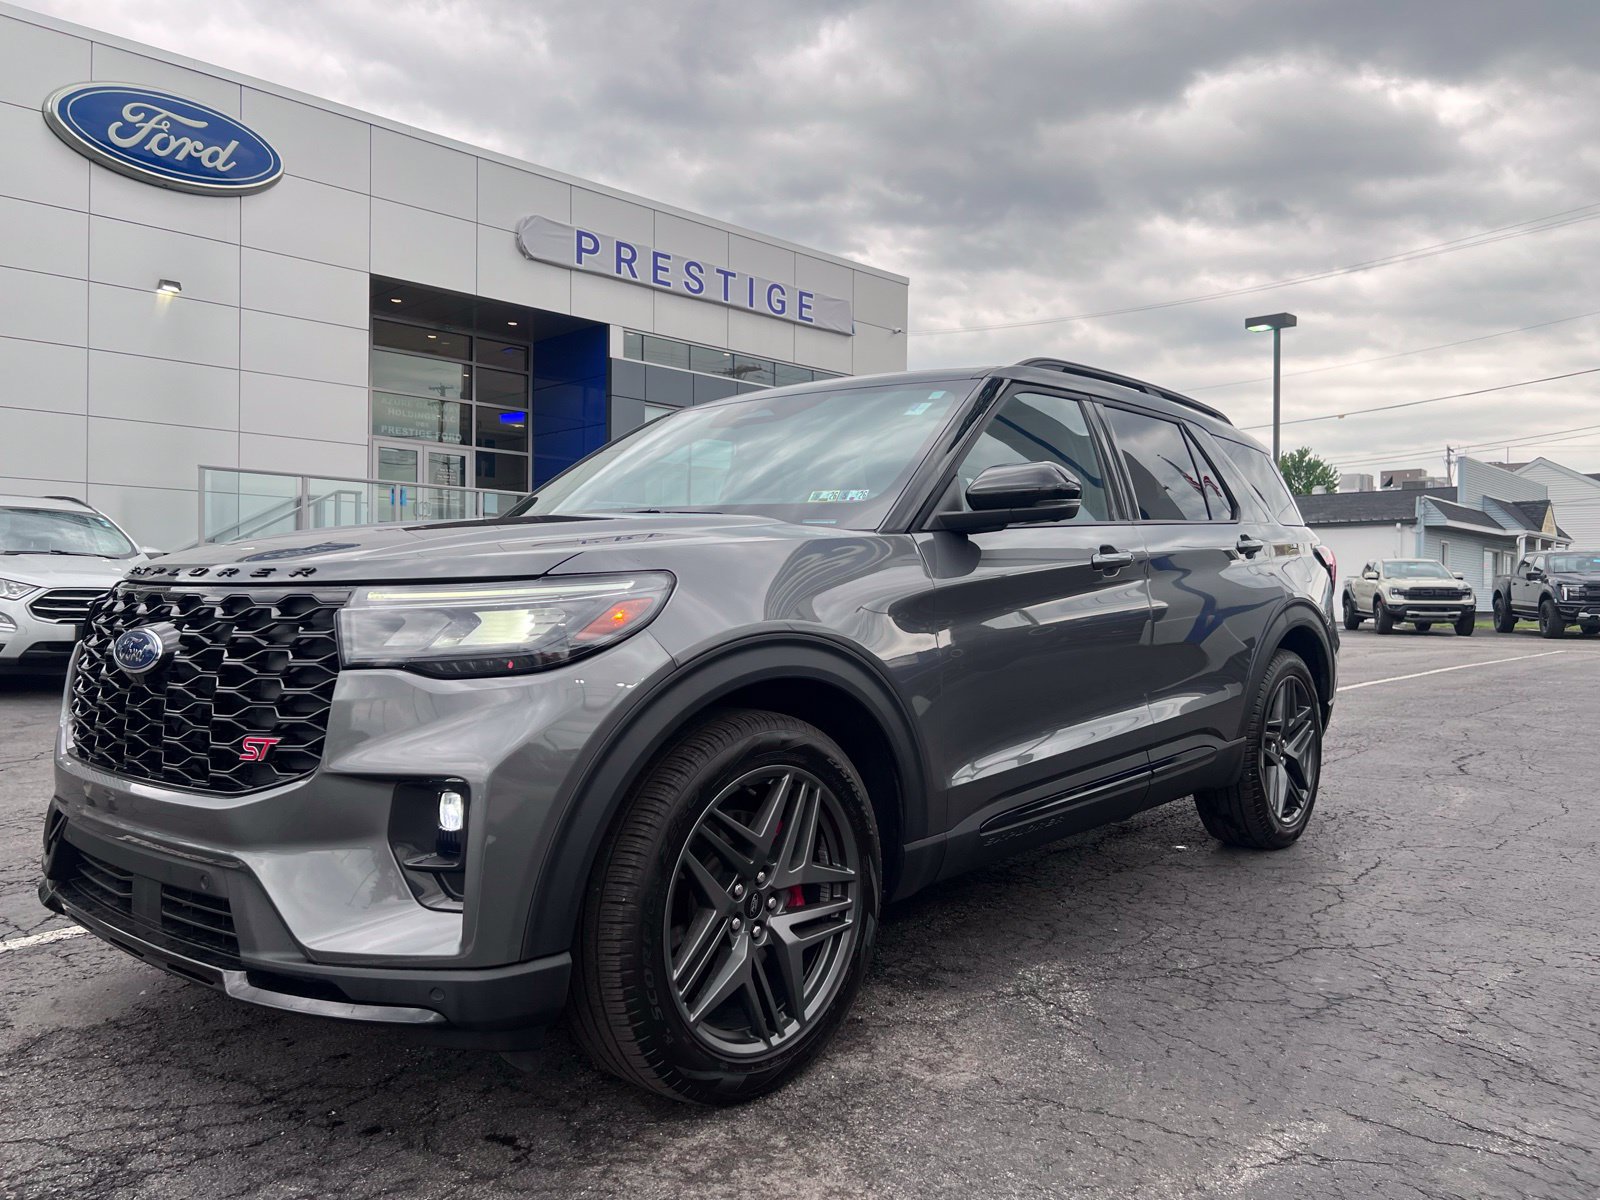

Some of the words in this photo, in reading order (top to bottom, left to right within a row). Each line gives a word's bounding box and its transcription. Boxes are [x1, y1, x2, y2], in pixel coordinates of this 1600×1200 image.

[107, 102, 240, 172] Ford
[574, 228, 815, 324] PRESTIGE
[381, 425, 433, 439] PRESTIGE
[435, 431, 462, 442] FORD
[129, 566, 317, 578] PLORER
[239, 736, 283, 762] ST
